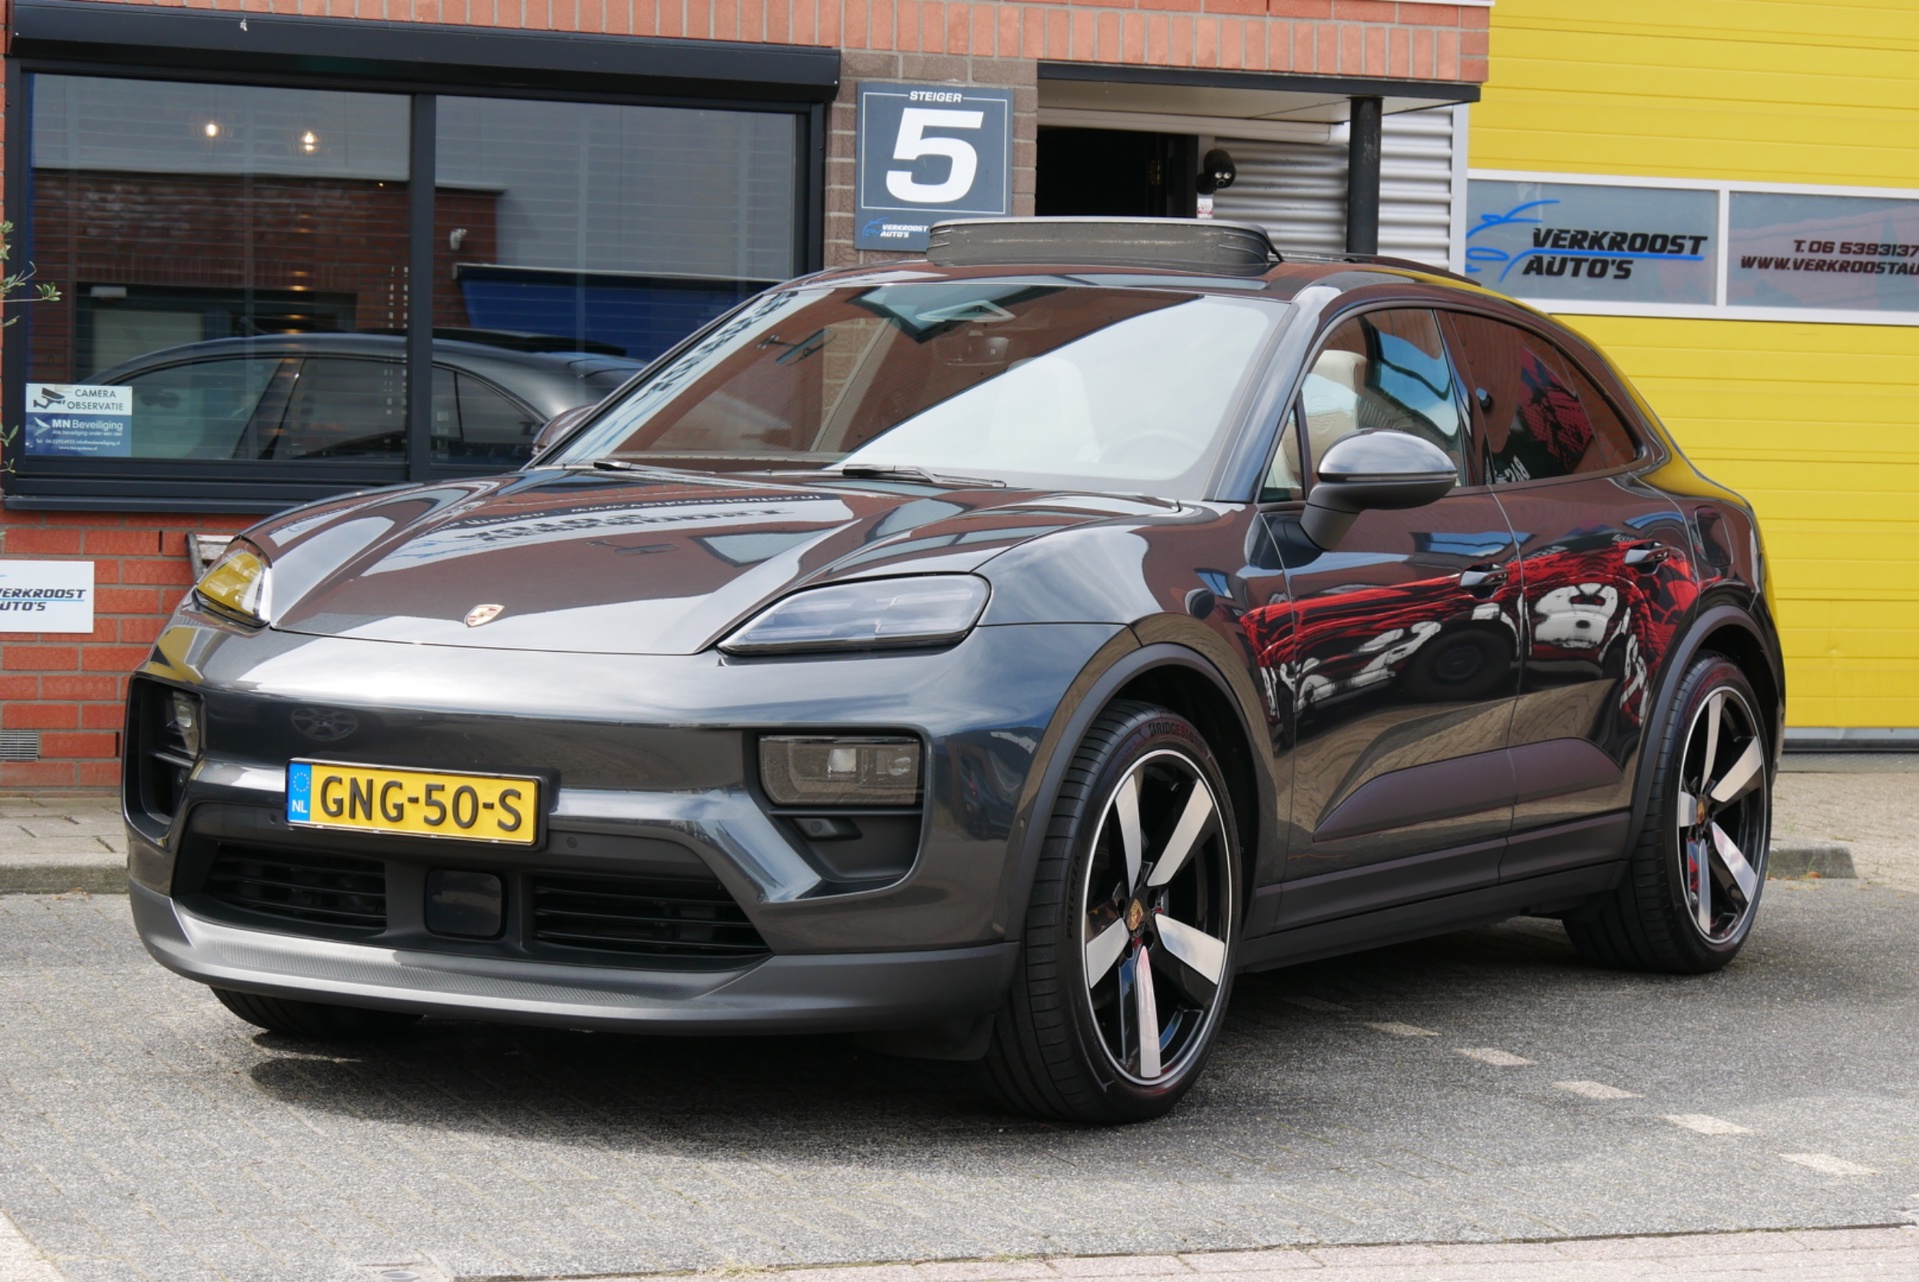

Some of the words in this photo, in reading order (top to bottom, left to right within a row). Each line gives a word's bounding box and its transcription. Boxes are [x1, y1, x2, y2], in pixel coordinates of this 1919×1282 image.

[909, 91, 962, 103] STEIGER
[886, 107, 984, 203] 5
[881, 223, 929, 233] VERKROOST
[1533, 228, 1708, 255] VERKROOST
[1794, 239, 1805, 253] T.
[1808, 240, 1836, 254] 06
[1522, 255, 1633, 279] AUTO'S
[74, 388, 117, 398] CAMERA
[67, 400, 124, 411] OBSERVATIE
[52, 419, 71, 429] MN
[72, 420, 123, 432] Beveiliging
[291, 799, 308, 814] NL
[319, 775, 523, 832] GNG-50-S
